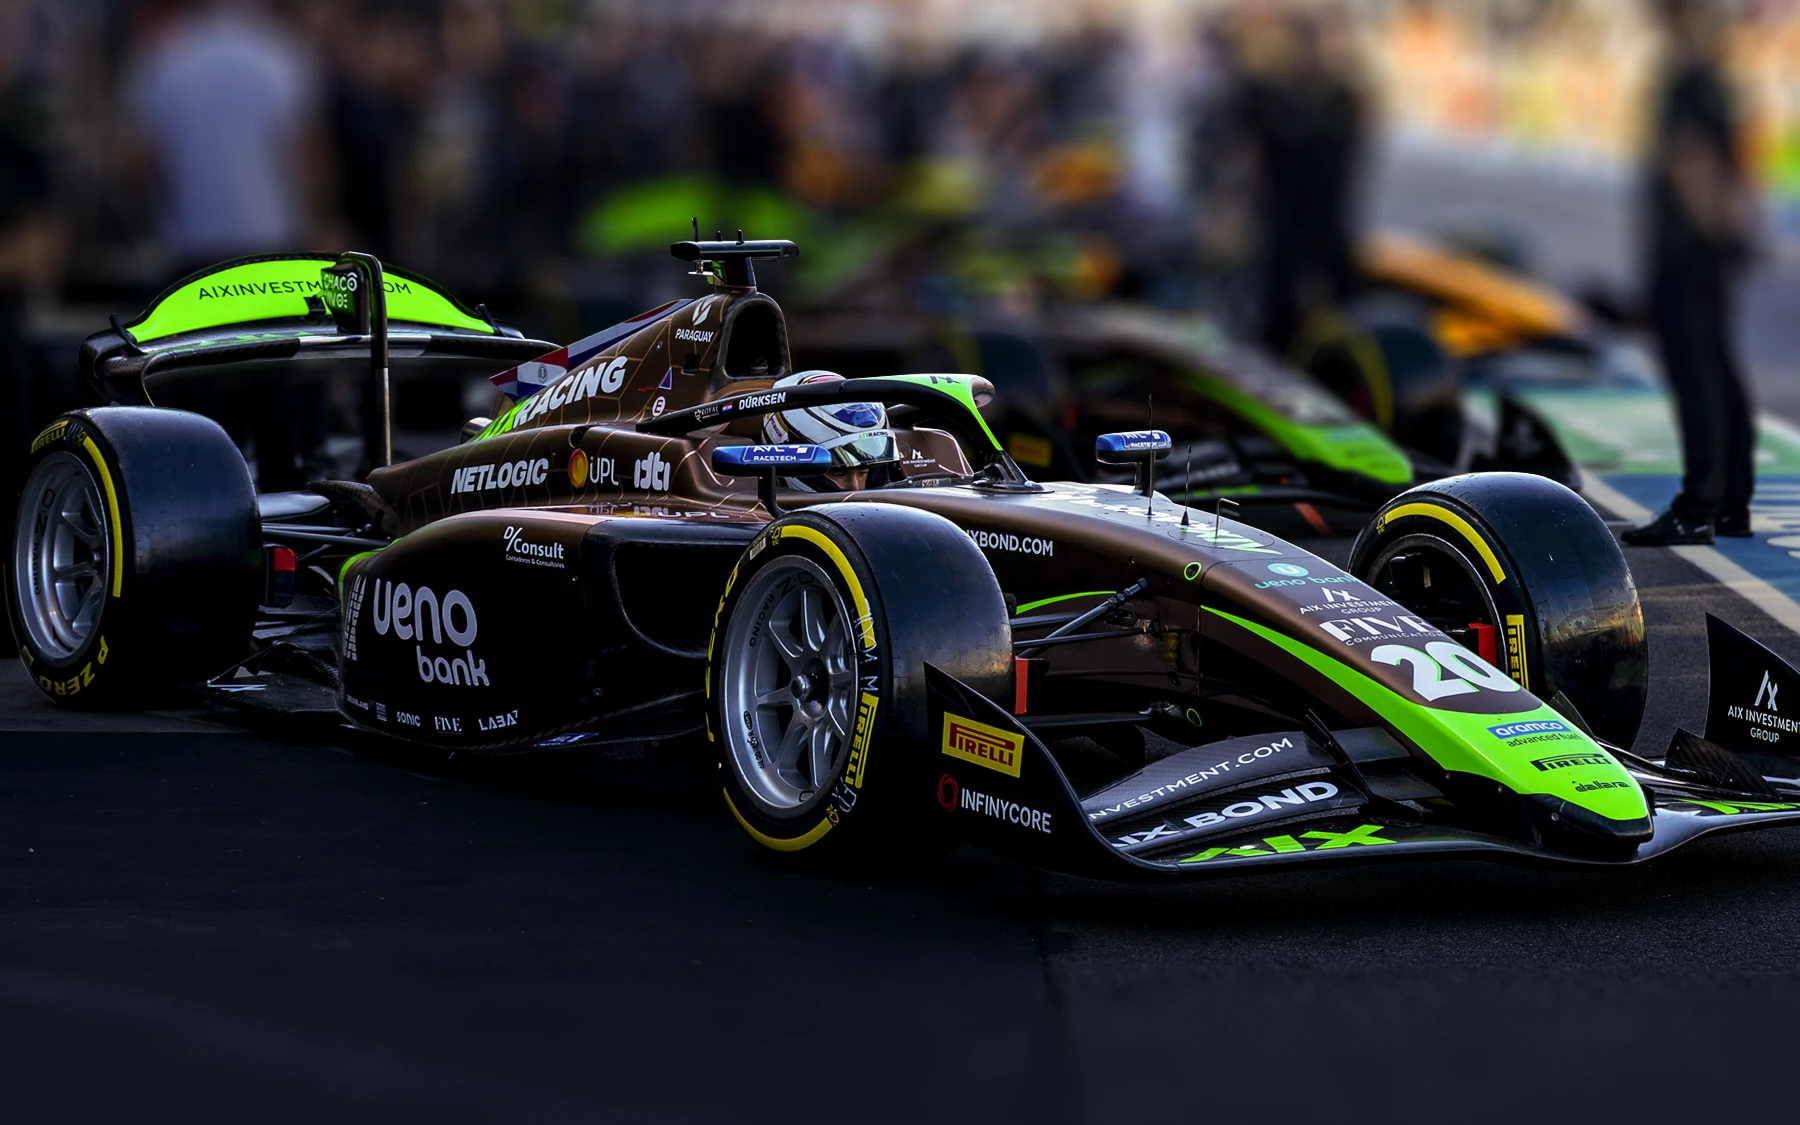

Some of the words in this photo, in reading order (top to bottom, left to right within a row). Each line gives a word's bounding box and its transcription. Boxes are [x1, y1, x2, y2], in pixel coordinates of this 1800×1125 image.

[675, 328, 714, 343] PARAGUAY
[513, 356, 629, 429] RACING
[738, 391, 786, 410] DÜRKSEN
[451, 458, 549, 494] NETLOGIC
[589, 456, 619, 486] UPL
[967, 530, 1054, 557] XBOND.COM
[1255, 578, 1307, 589] ueno
[373, 578, 478, 647] ueno
[750, 593, 775, 648] RACING
[1300, 605, 1323, 615] AIX
[1341, 607, 1382, 615] GROUP
[40, 662, 96, 695] ZERO
[417, 645, 491, 686] bank
[1371, 641, 1521, 702] 20
[1727, 705, 1744, 720] AIX
[844, 692, 880, 789] PIRELLI
[1495, 721, 1564, 736] aramco
[1506, 733, 1560, 748] advanced
[1558, 732, 1583, 741] fuel
[1750, 727, 1780, 744] GROUP
[949, 722, 1015, 767] PIRELLI
[1530, 753, 1612, 772] PIRELLI
[1573, 780, 1630, 793] dallara
[961, 788, 1052, 833] INFINYCORE
[1184, 781, 1339, 829] BOND
